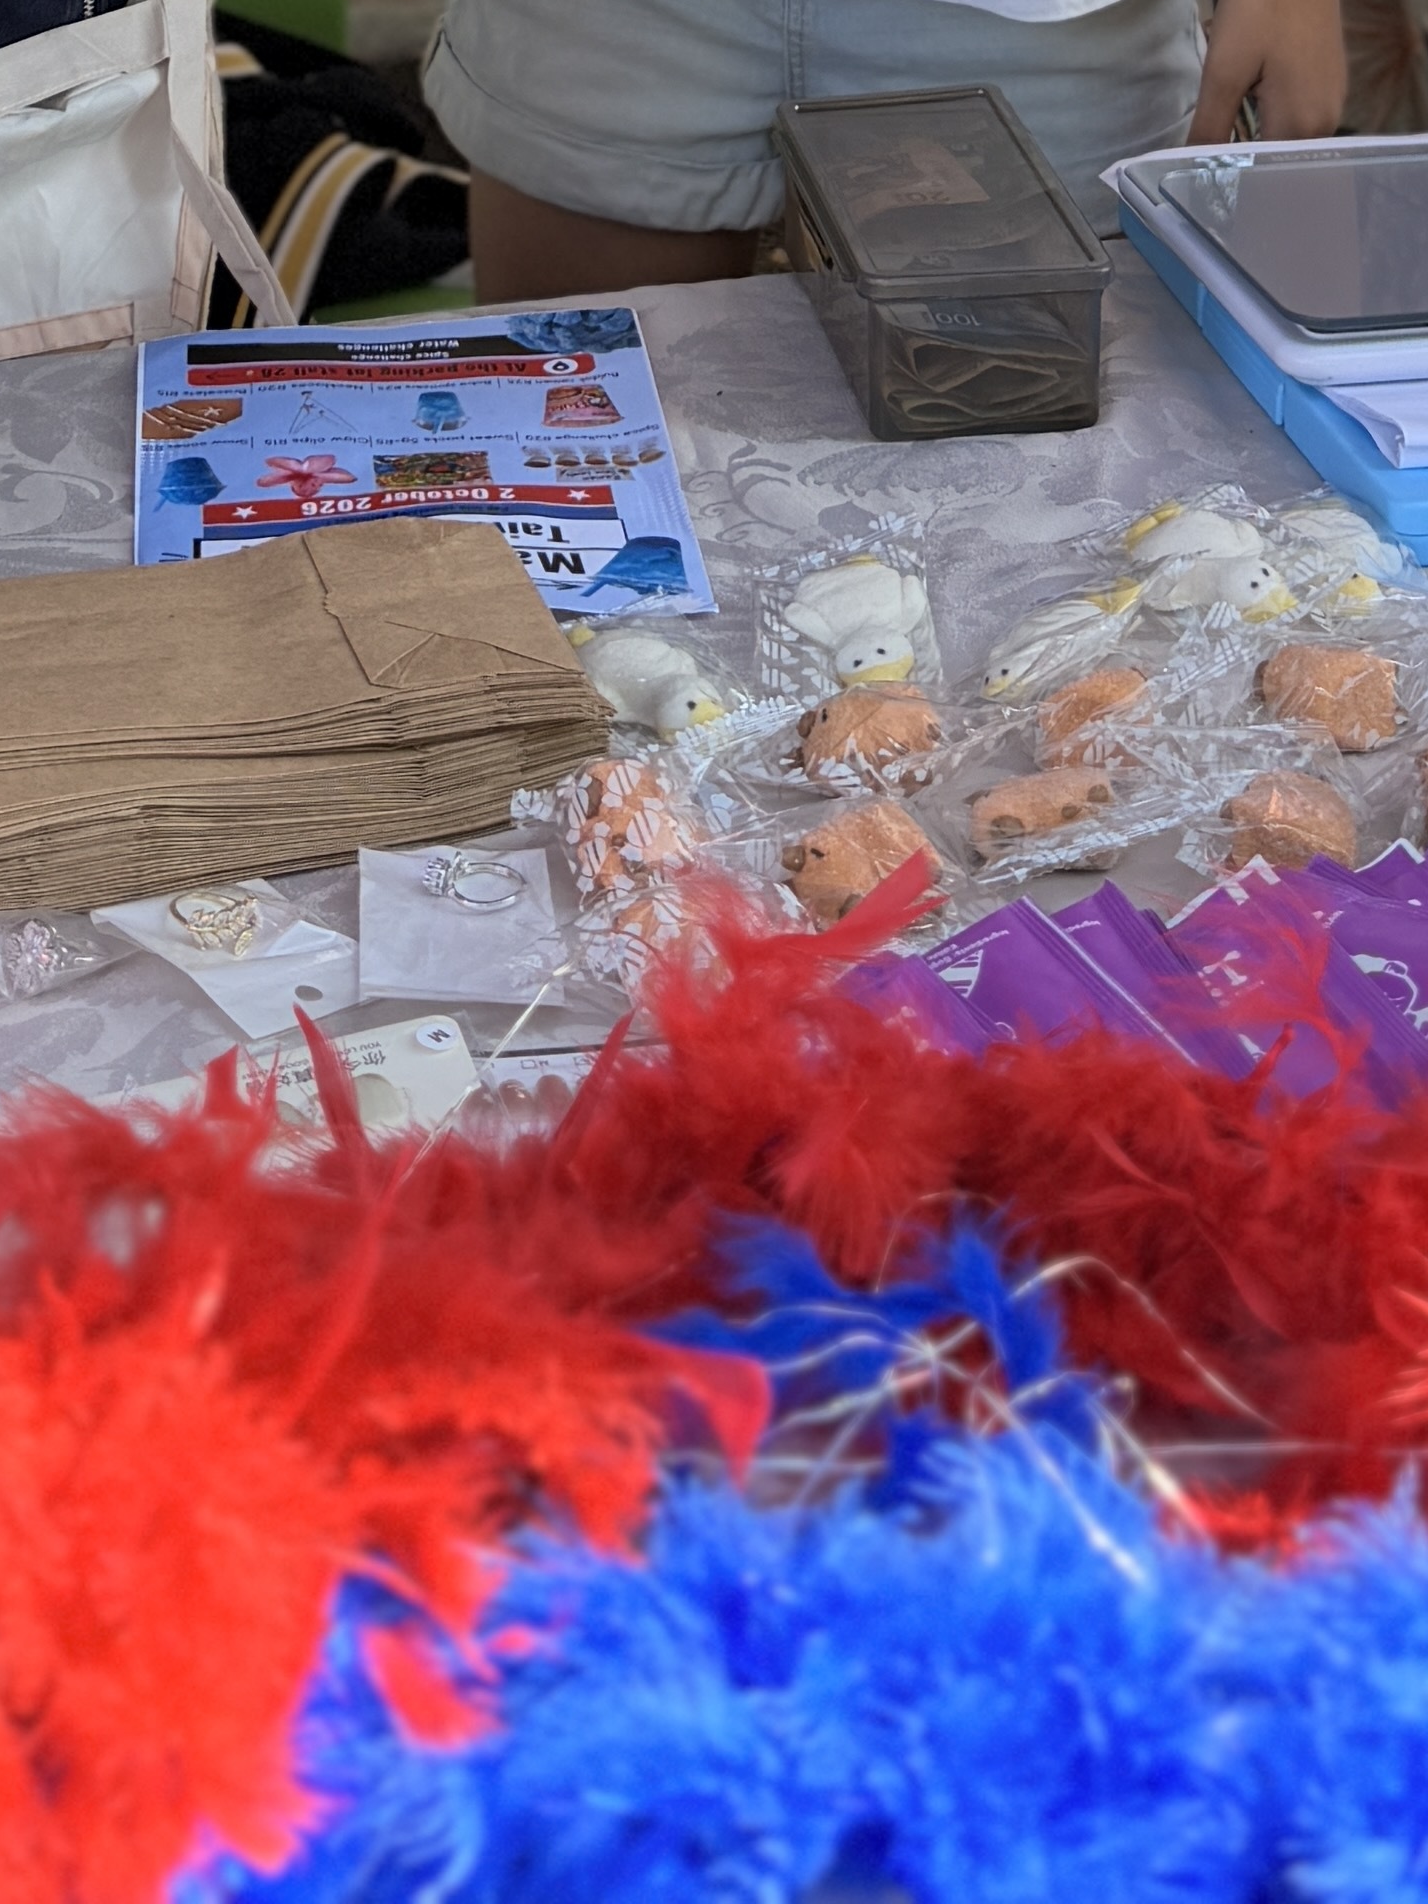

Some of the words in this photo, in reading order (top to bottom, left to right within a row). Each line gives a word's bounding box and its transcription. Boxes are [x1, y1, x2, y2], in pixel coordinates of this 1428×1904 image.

[936, 312, 981, 327] 100
[337, 343, 414, 353] challenges
[418, 339, 460, 348] Water
[351, 353, 412, 361] challenge
[379, 364, 459, 377] parking
[465, 363, 498, 372] the
[381, 488, 490, 504] October
[498, 487, 516, 499] 2
[300, 496, 372, 516] 2026
[515, 551, 586, 574] Ma
[427, 1028, 451, 1044] M
